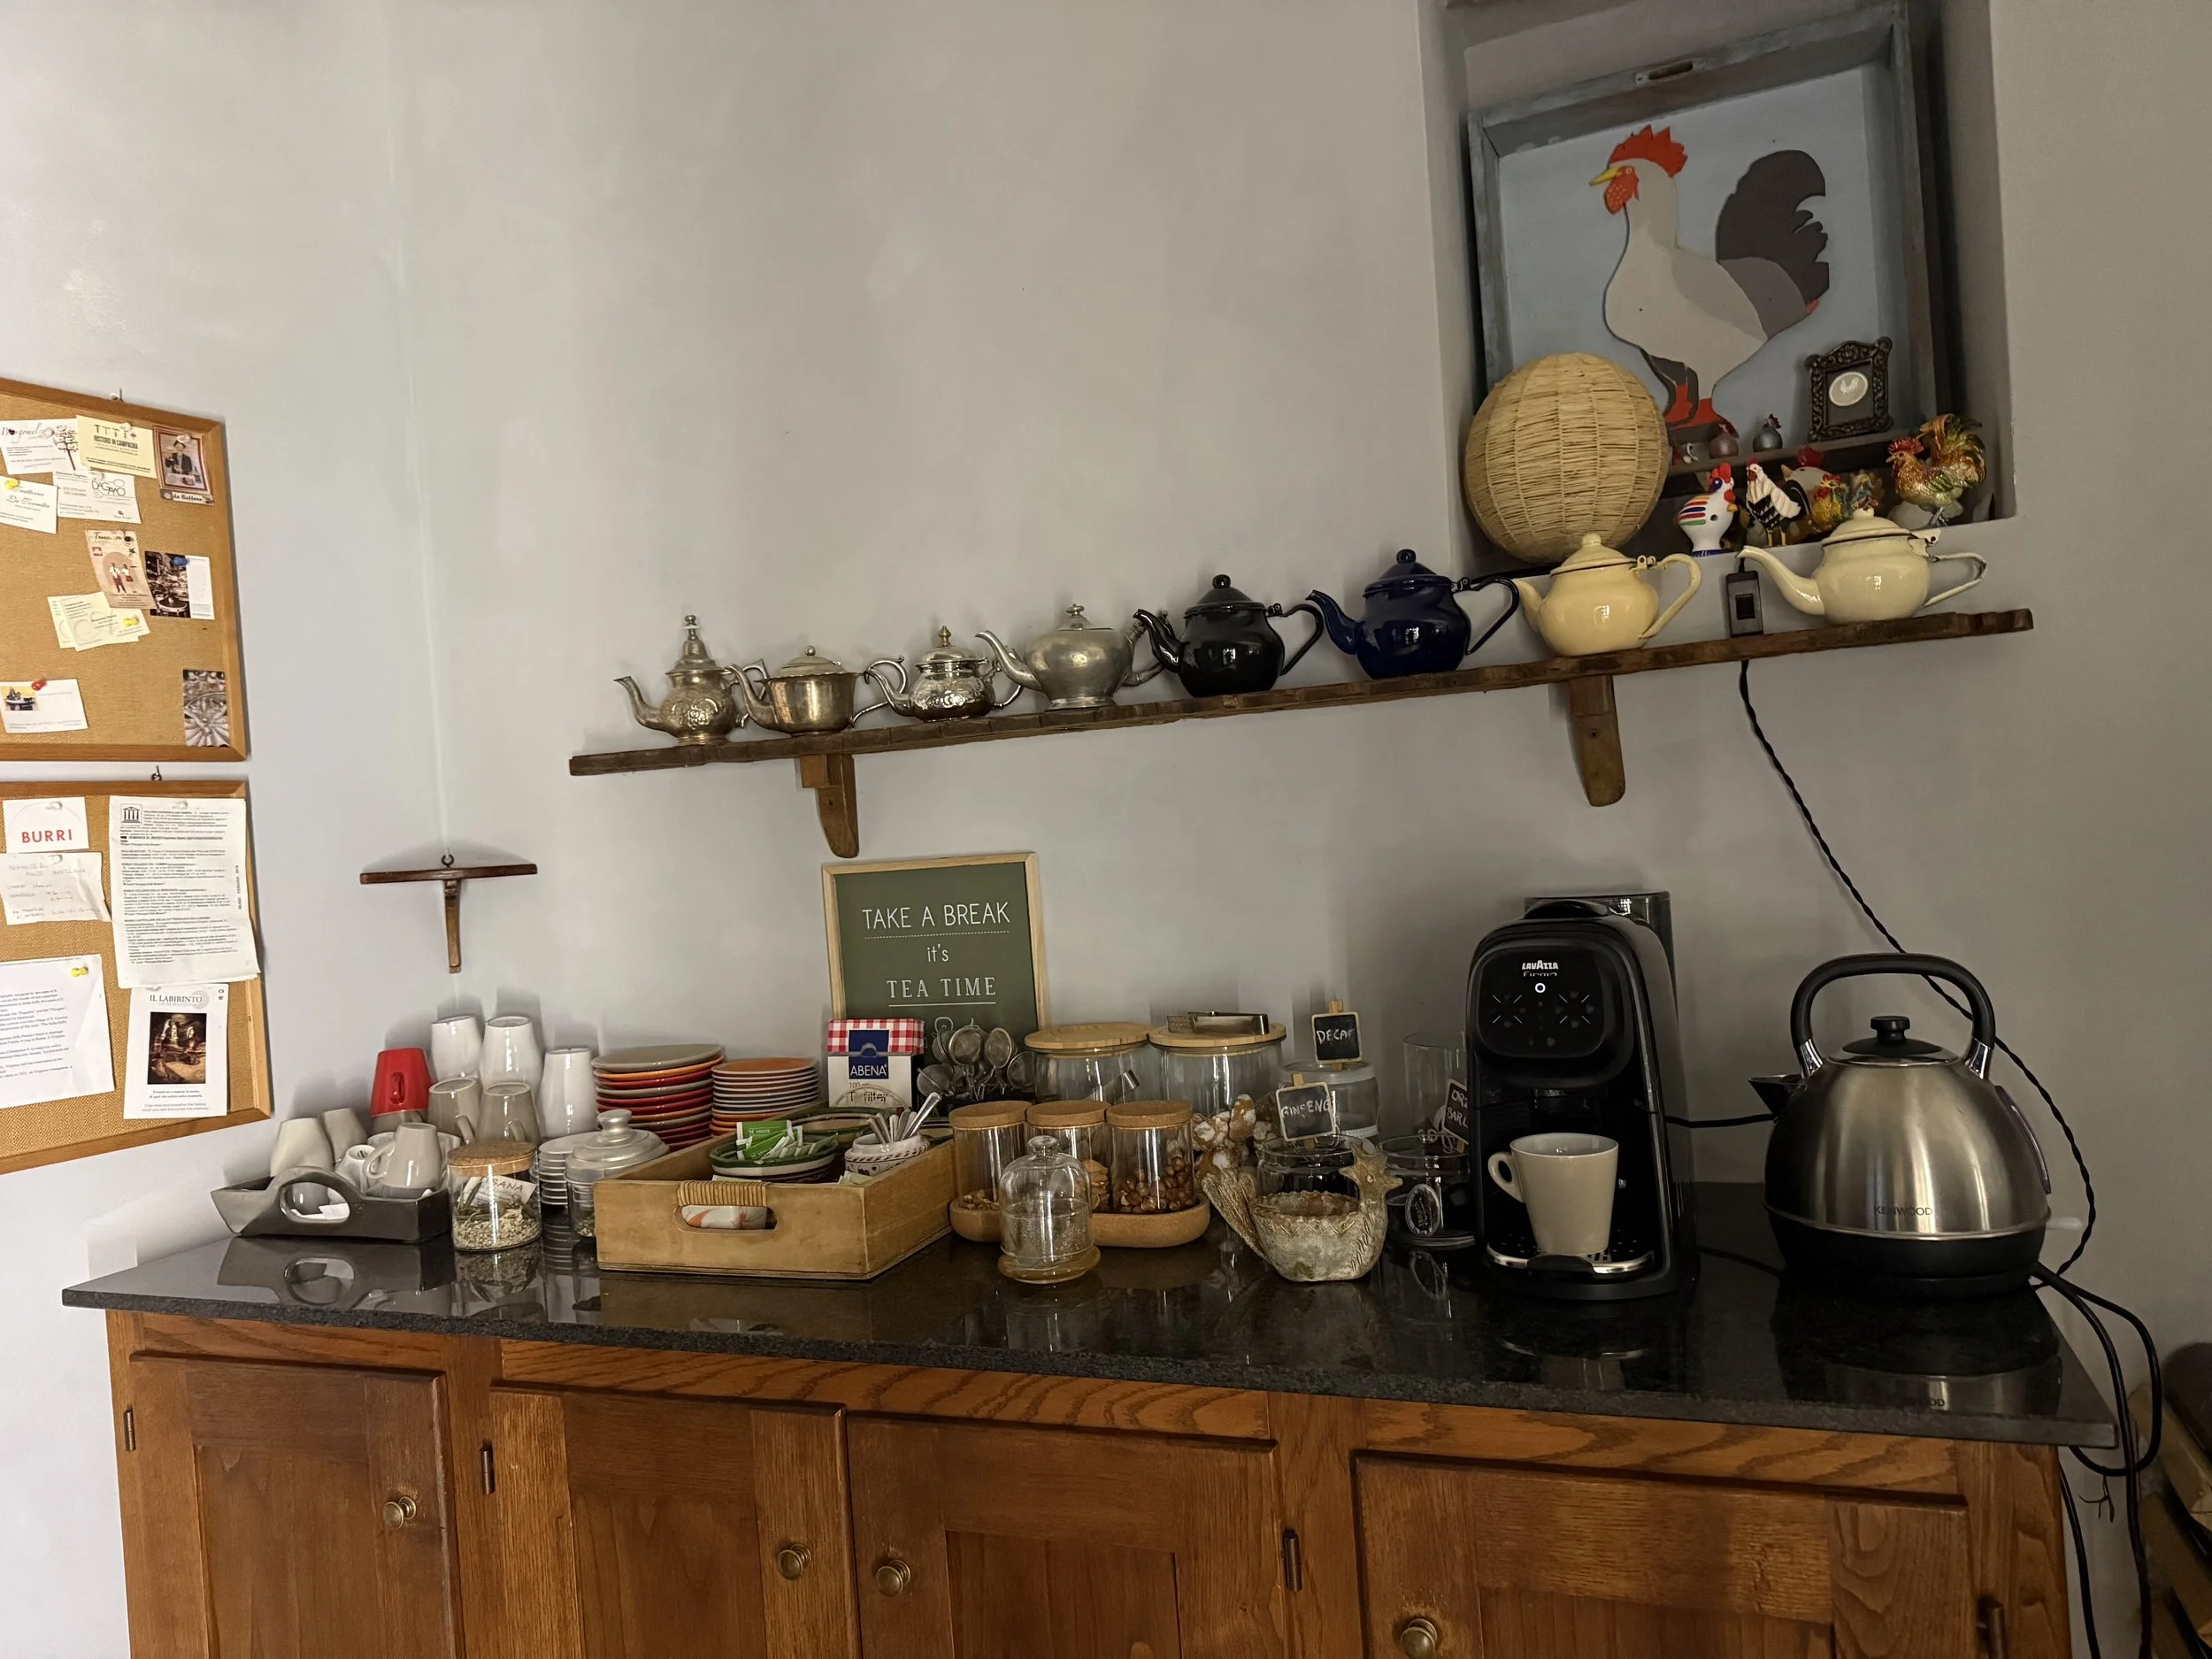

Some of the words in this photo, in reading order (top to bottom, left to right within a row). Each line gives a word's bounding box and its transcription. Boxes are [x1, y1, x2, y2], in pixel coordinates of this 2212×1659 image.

[21, 829, 72, 843] BURRI
[862, 907, 911, 929] TAKE
[922, 905, 935, 927] A
[943, 901, 1010, 926] BREAK
[927, 943, 949, 962] it's
[1522, 960, 1559, 970] LAVAZZA
[887, 979, 929, 998] TEA
[941, 977, 996, 997] TIME
[159, 995, 203, 1003] LABIRINTO
[1316, 1028, 1355, 1044] DECAF
[1280, 1099, 1331, 1118] GINSENG
[1447, 1107, 1469, 1129] BARL
[1874, 1206, 1932, 1216] KENWOOD
